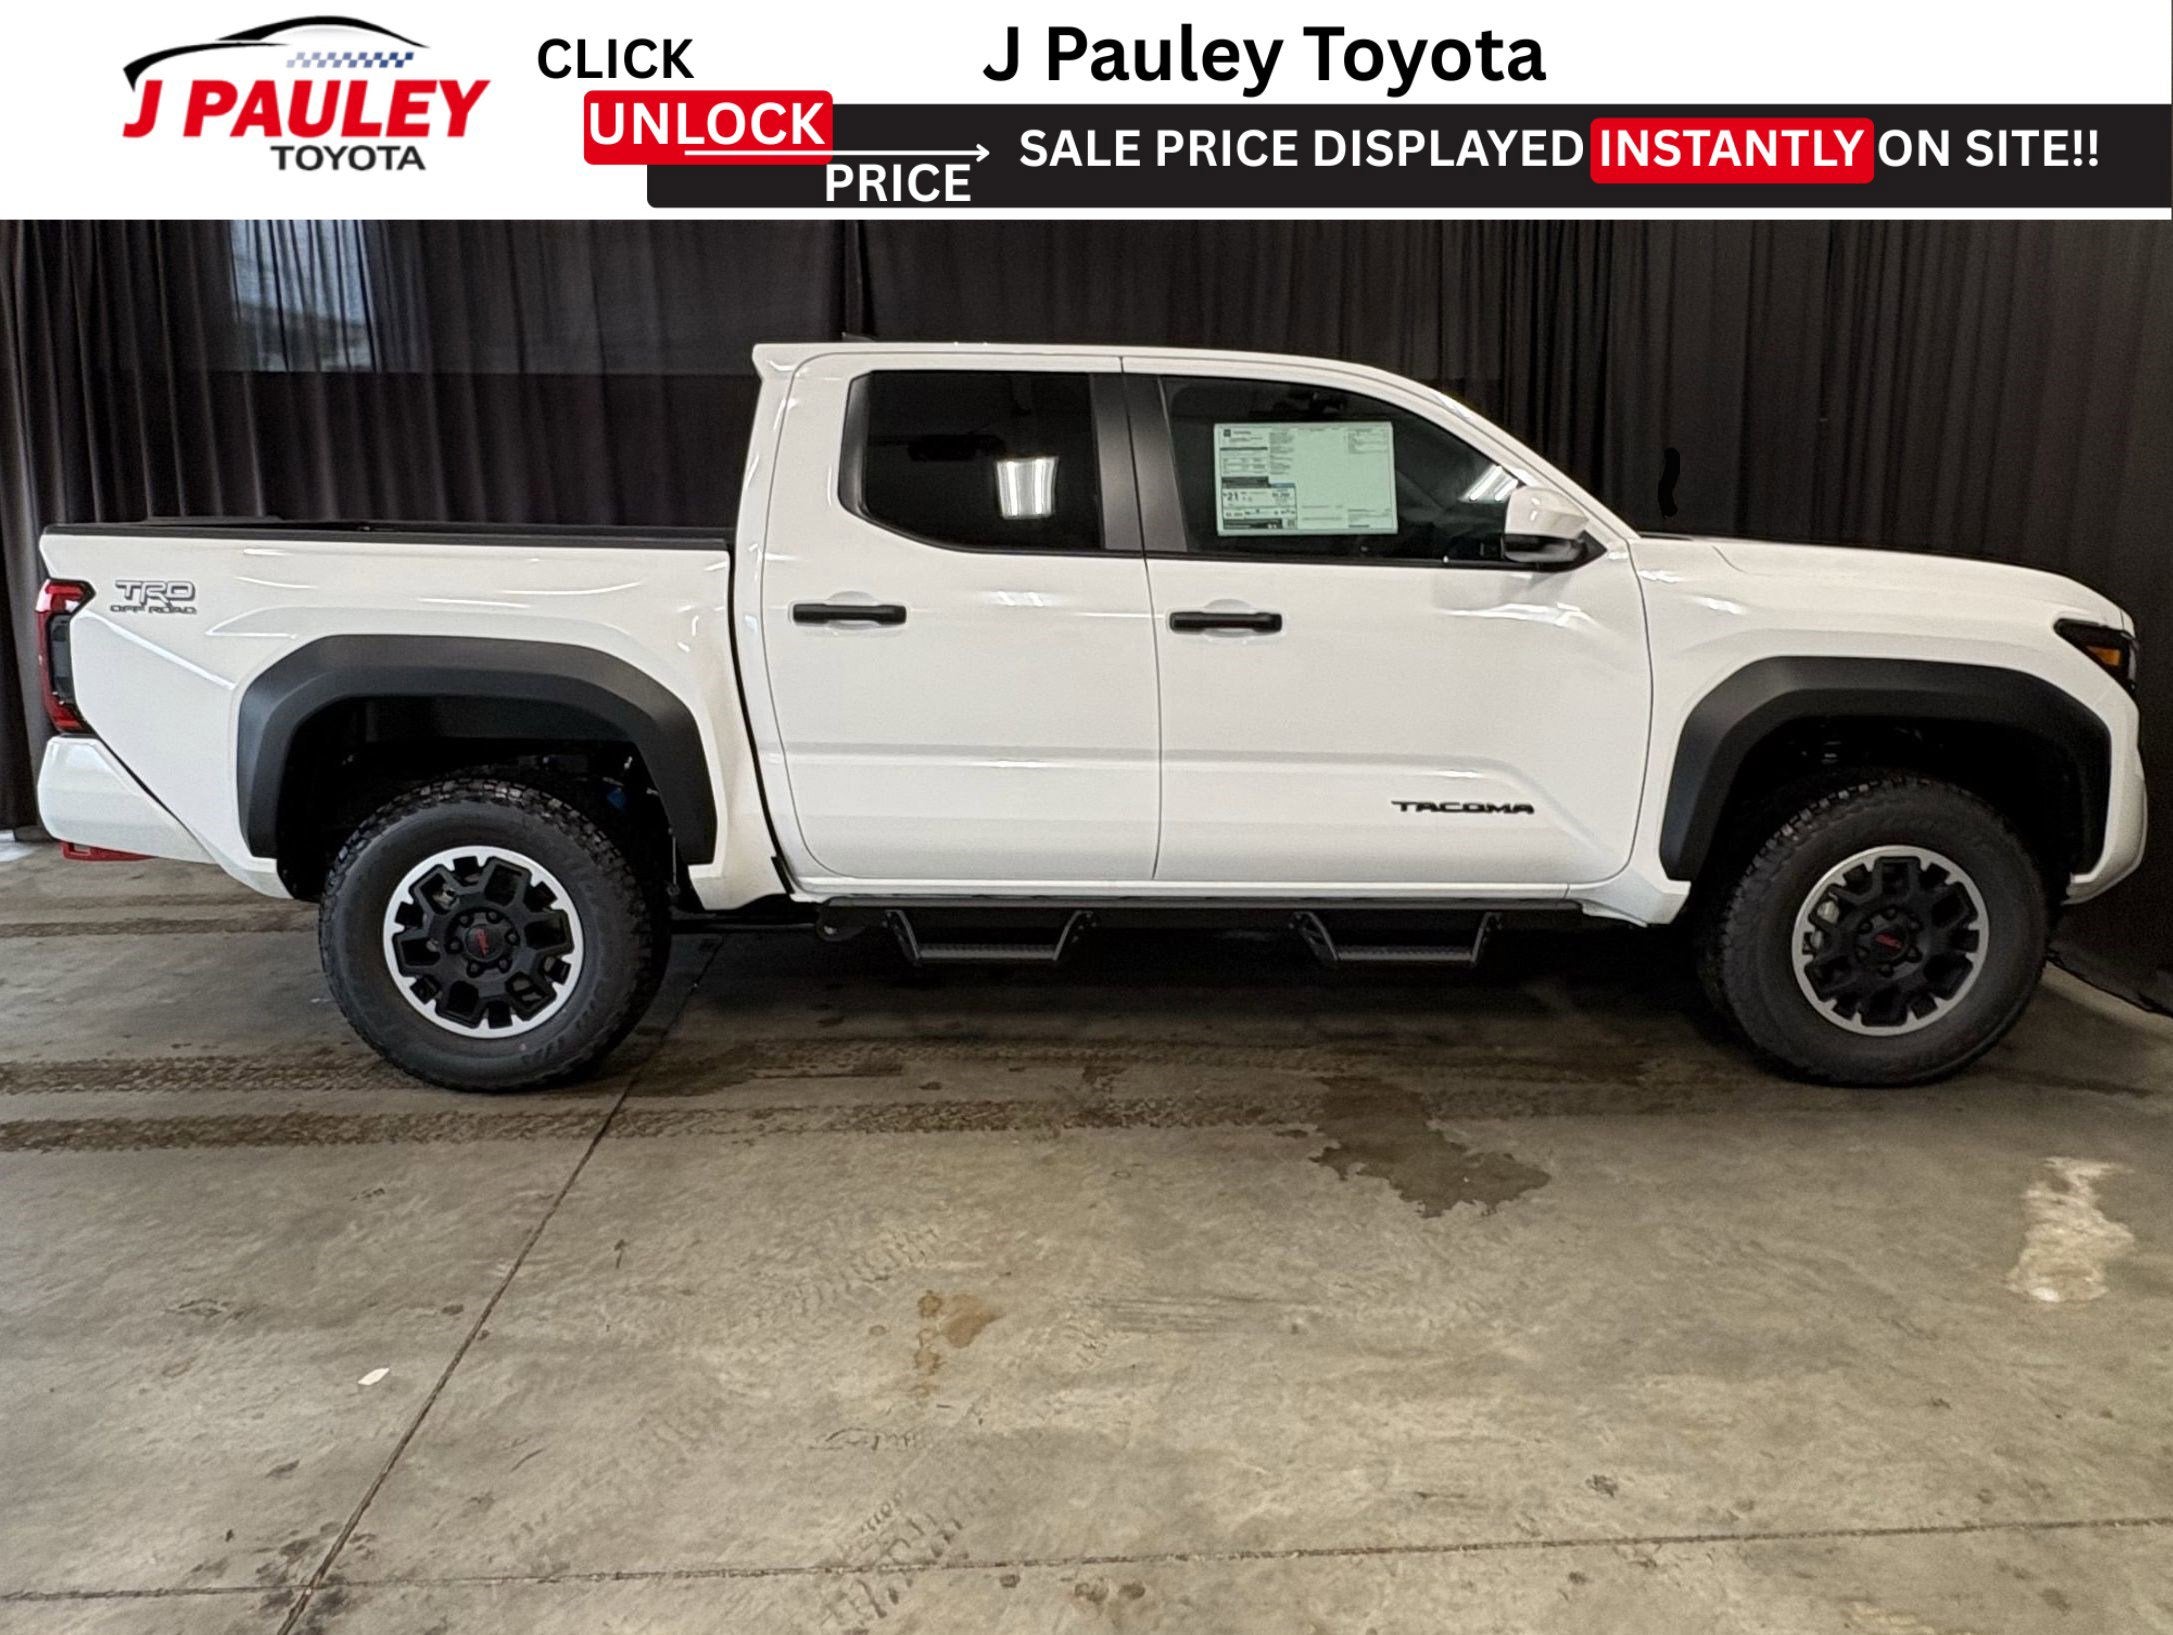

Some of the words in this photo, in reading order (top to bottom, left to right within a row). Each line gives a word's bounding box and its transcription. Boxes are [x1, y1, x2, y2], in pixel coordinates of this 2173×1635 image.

[115, 580, 196, 607] TRD
[110, 604, 146, 613] OFF
[148, 605, 197, 615] ROAD
[1391, 801, 1535, 815] TACOMA
